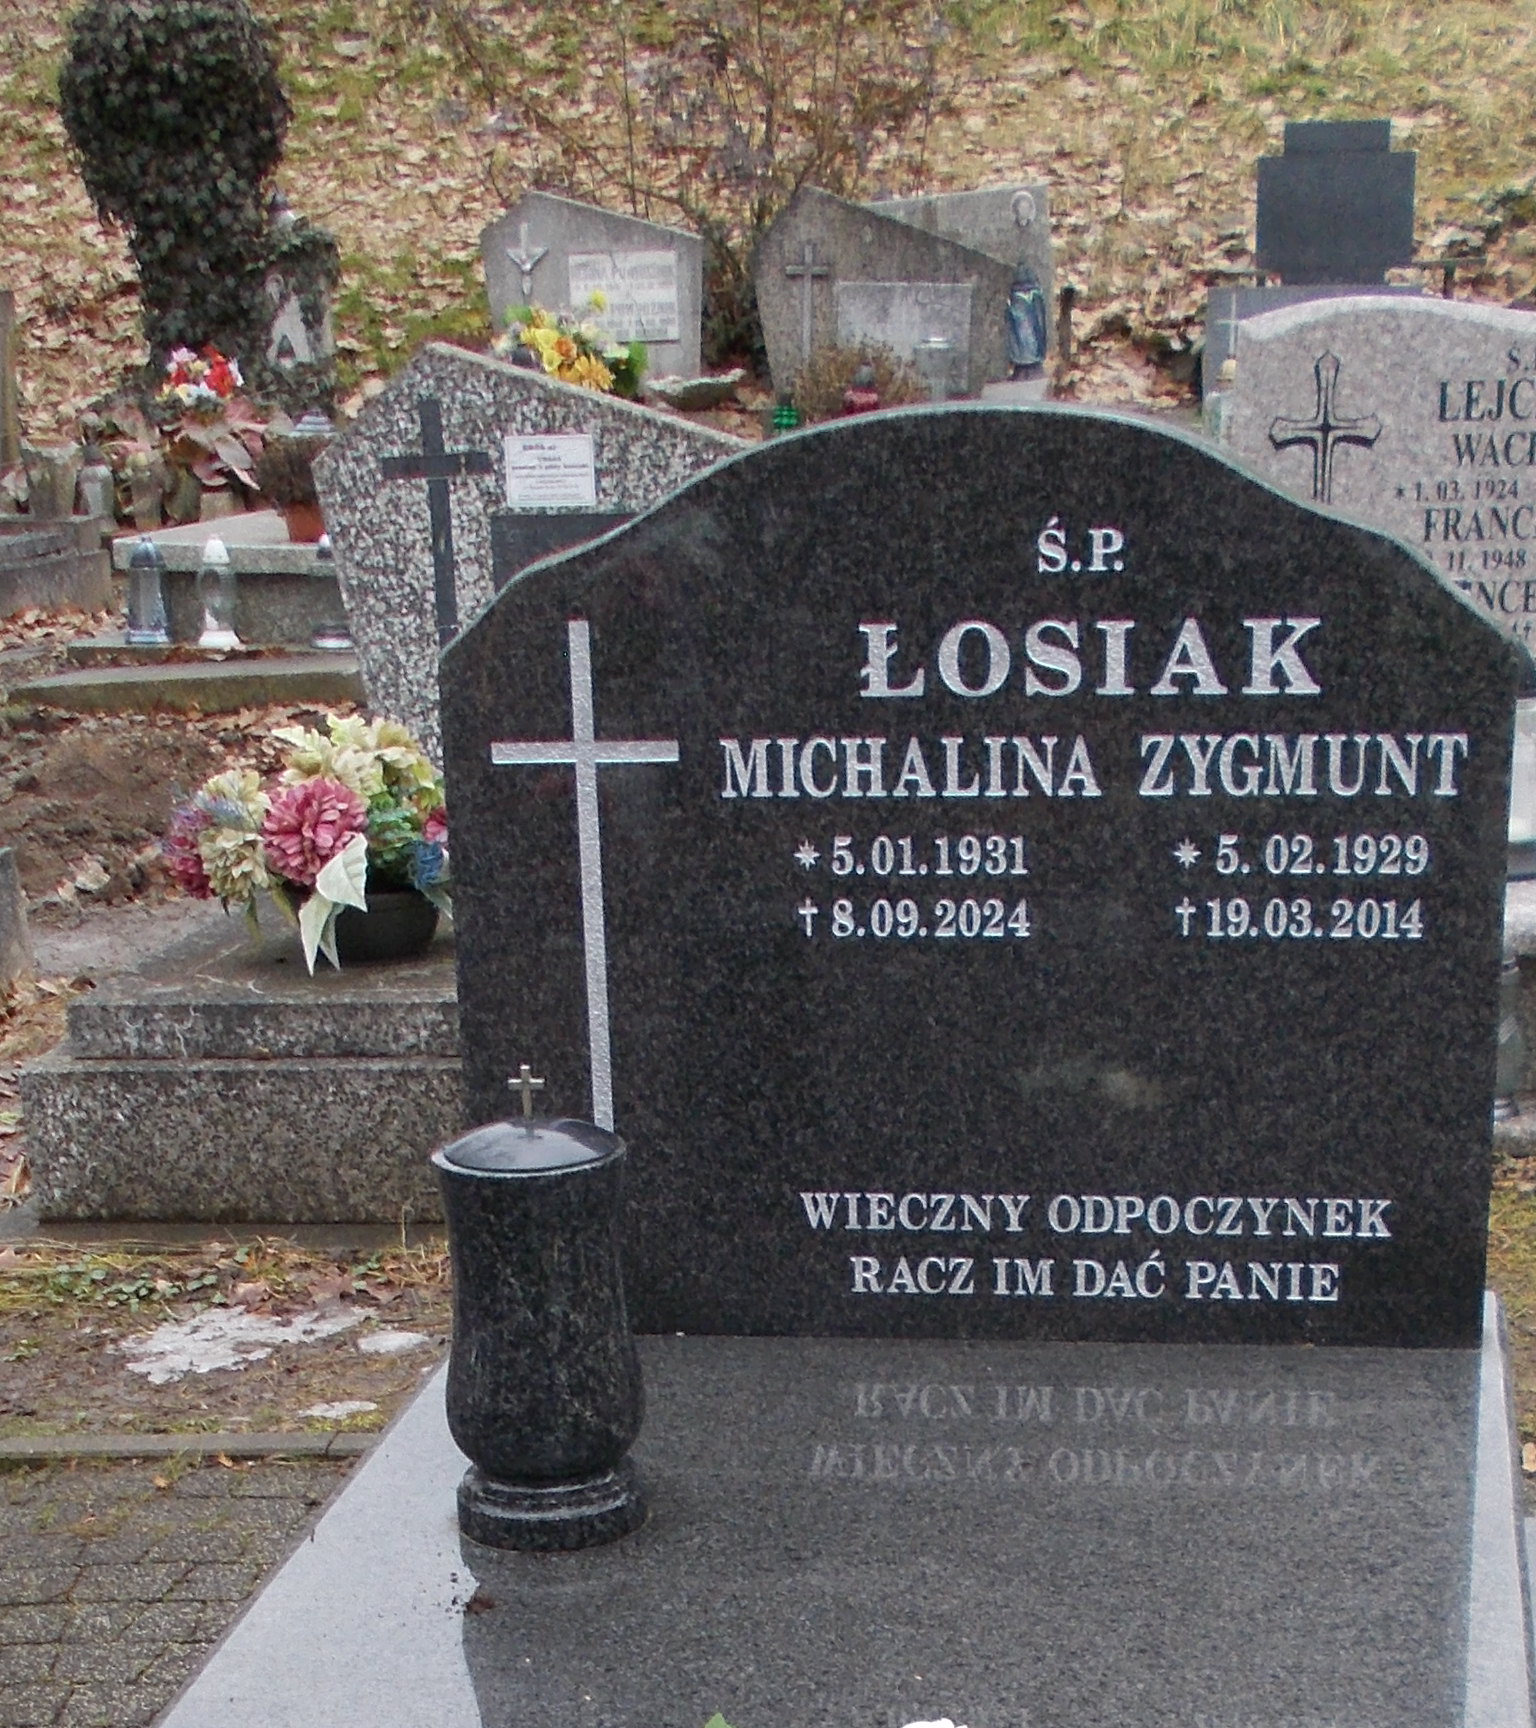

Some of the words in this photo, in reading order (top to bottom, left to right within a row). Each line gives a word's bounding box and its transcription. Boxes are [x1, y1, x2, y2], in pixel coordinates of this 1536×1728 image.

[1036, 516, 1125, 574] Ś.P.
[858, 617, 1322, 698] ŁOSIAK
[719, 735, 1103, 799] MICHALINA
[1138, 733, 1469, 797] ZYGMUNT
[831, 836, 1029, 876] 5.01.1931
[831, 898, 1032, 938] 8.09.2024
[1205, 897, 1424, 938] 19.03.2014
[799, 1191, 1031, 1233] WIECZNY
[1047, 1195, 1392, 1238] ODPOCZYNEK
[850, 1256, 975, 1295] RACZ
[992, 1258, 1055, 1297] IM
[1072, 1249, 1167, 1299] DAĆ
[1184, 1261, 1340, 1301] PANIE
